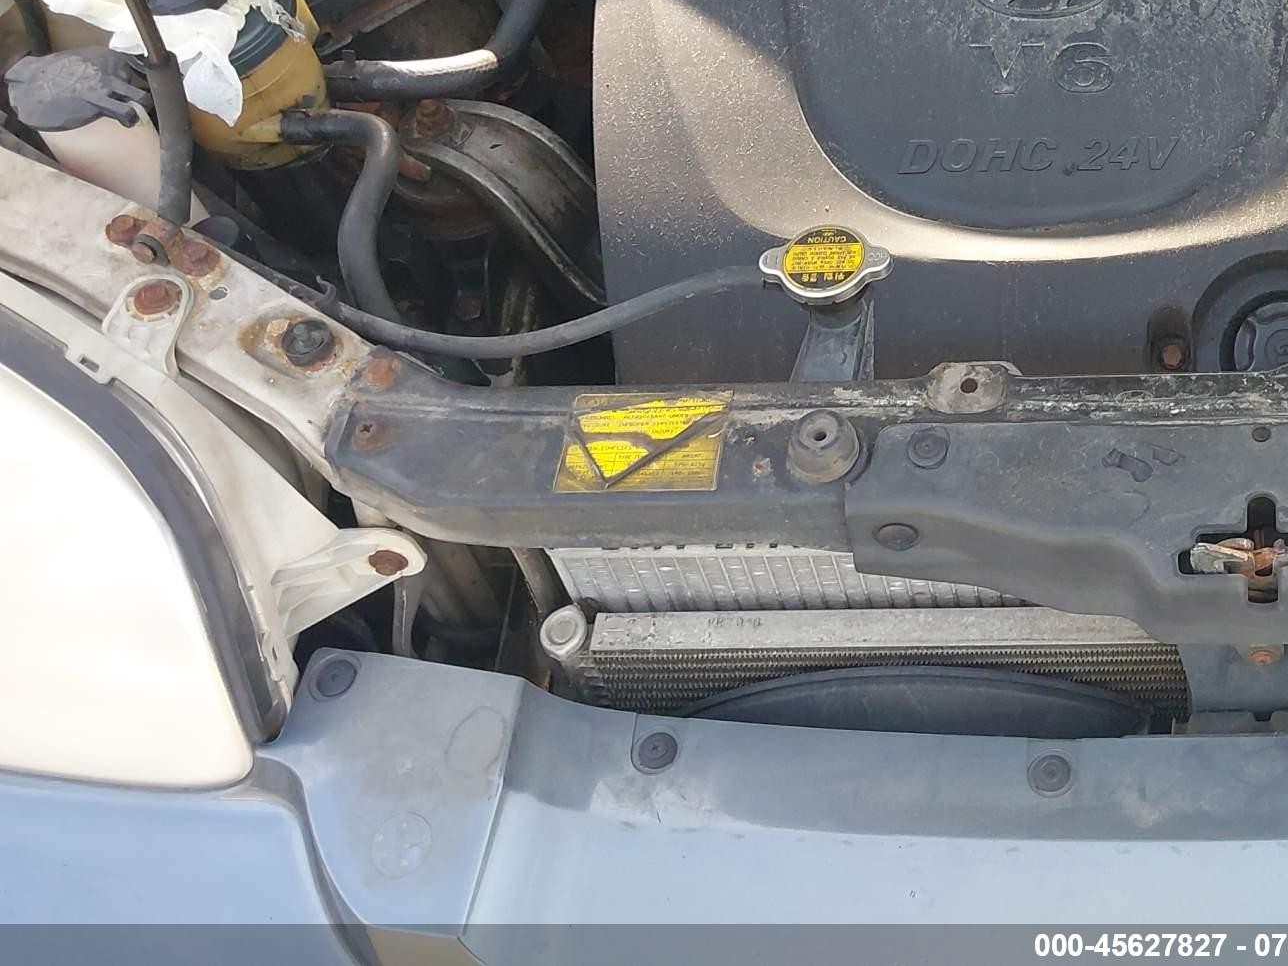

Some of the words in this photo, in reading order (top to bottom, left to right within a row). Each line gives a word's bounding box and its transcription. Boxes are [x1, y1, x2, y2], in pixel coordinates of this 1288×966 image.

[968, 40, 1114, 96] V6
[896, 137, 1057, 175] DOHC
[1075, 136, 1182, 172] 24V
[807, 235, 847, 244] CAUTION
